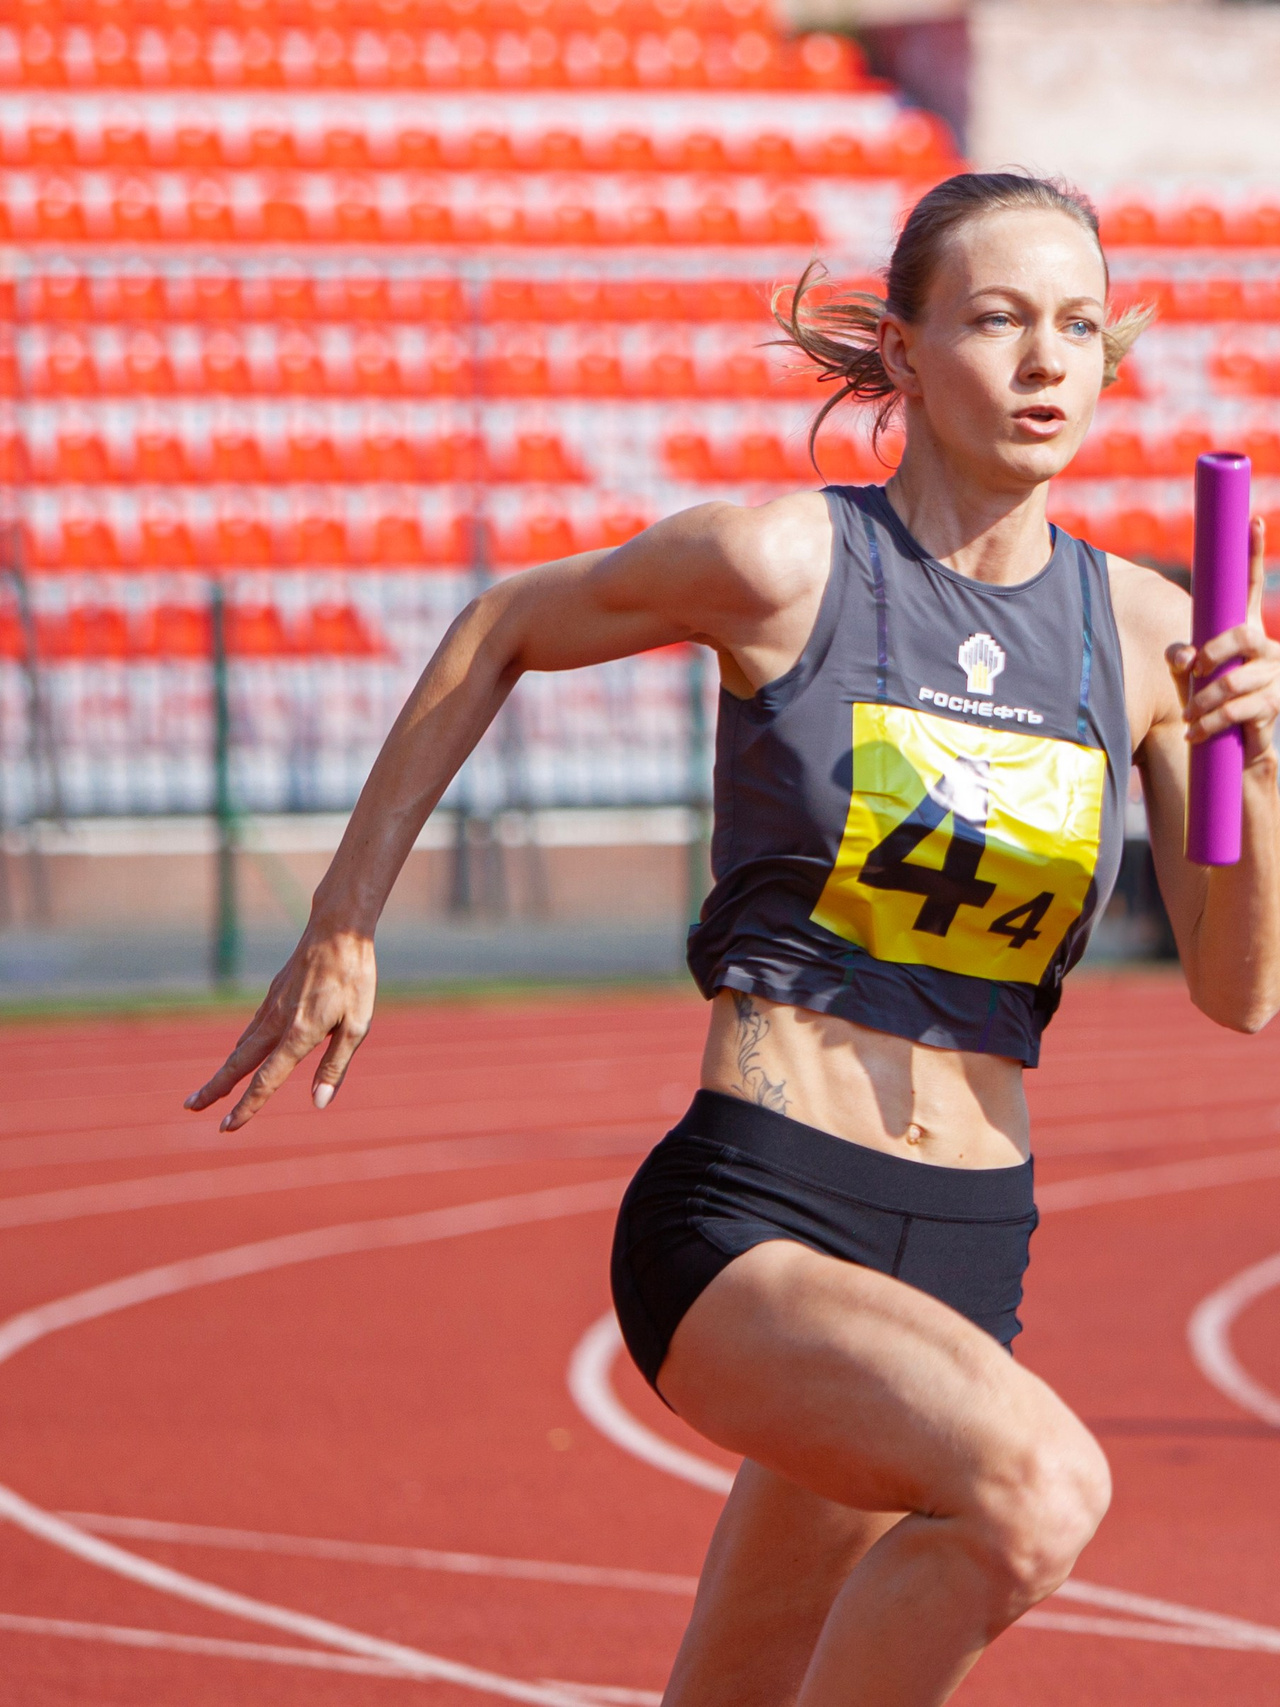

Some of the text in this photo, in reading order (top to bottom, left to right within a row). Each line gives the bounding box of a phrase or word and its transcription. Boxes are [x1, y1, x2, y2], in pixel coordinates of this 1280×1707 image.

[919, 687, 1044, 724] РОСНЕФТЬ
[857, 756, 1055, 949] 4 4
